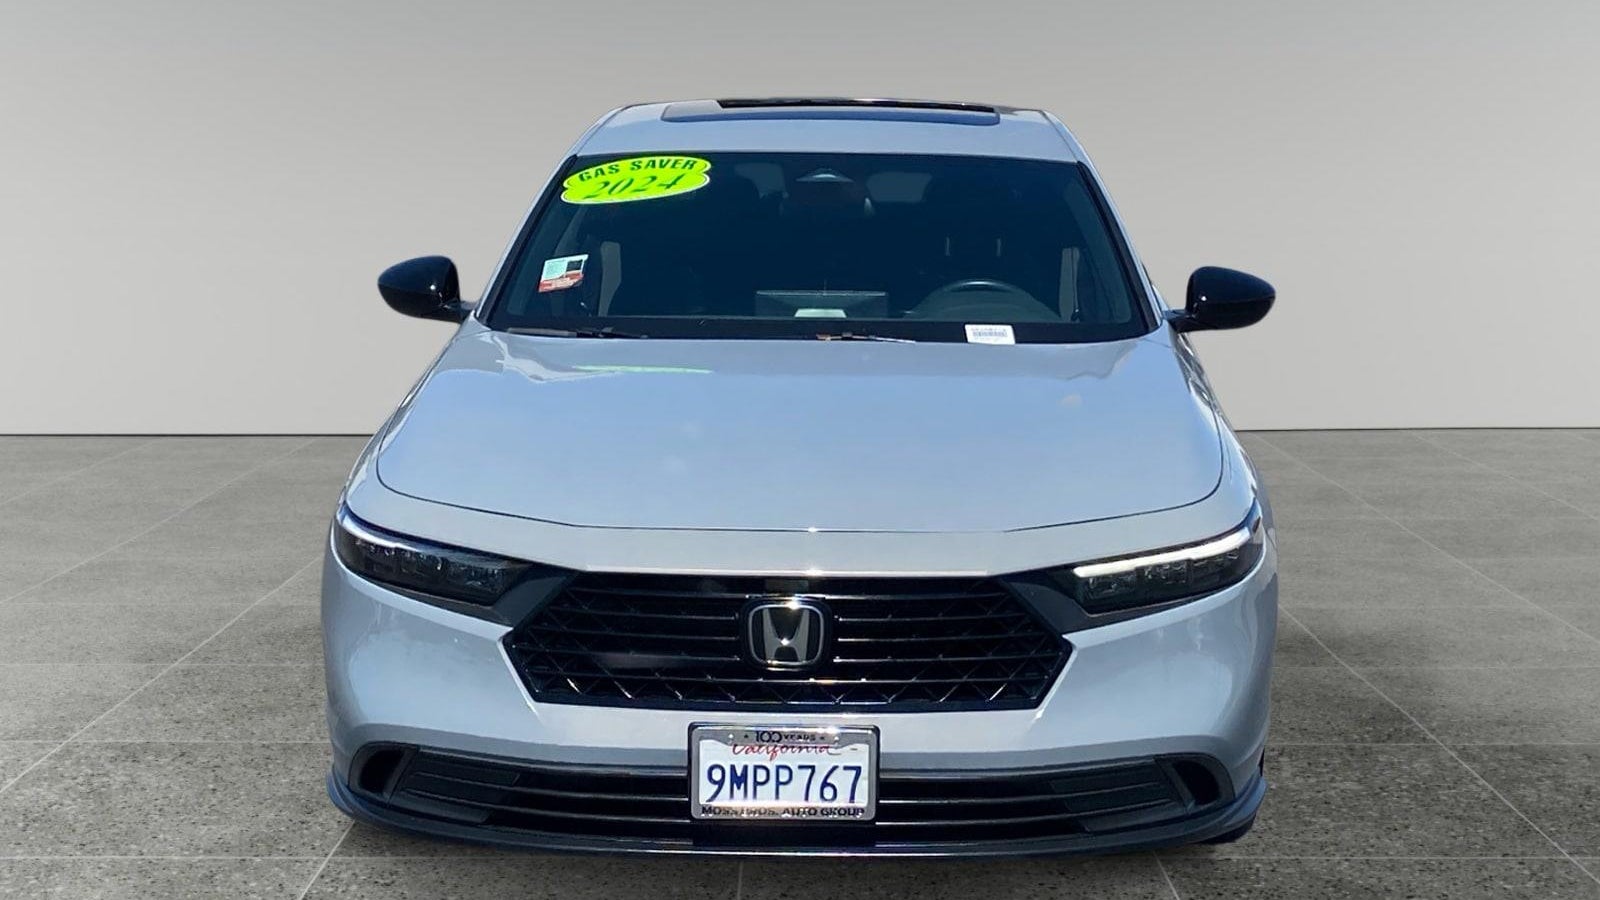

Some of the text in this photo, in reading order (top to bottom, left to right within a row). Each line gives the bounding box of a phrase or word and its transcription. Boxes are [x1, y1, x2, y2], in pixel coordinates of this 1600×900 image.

[578, 158, 698, 182] GAS SAVER
[582, 172, 687, 200] 2024
[755, 730, 783, 743] 100
[705, 763, 863, 804] 9MPP767
[781, 806, 818, 817] AUTO
[820, 806, 866, 816] GROUP
